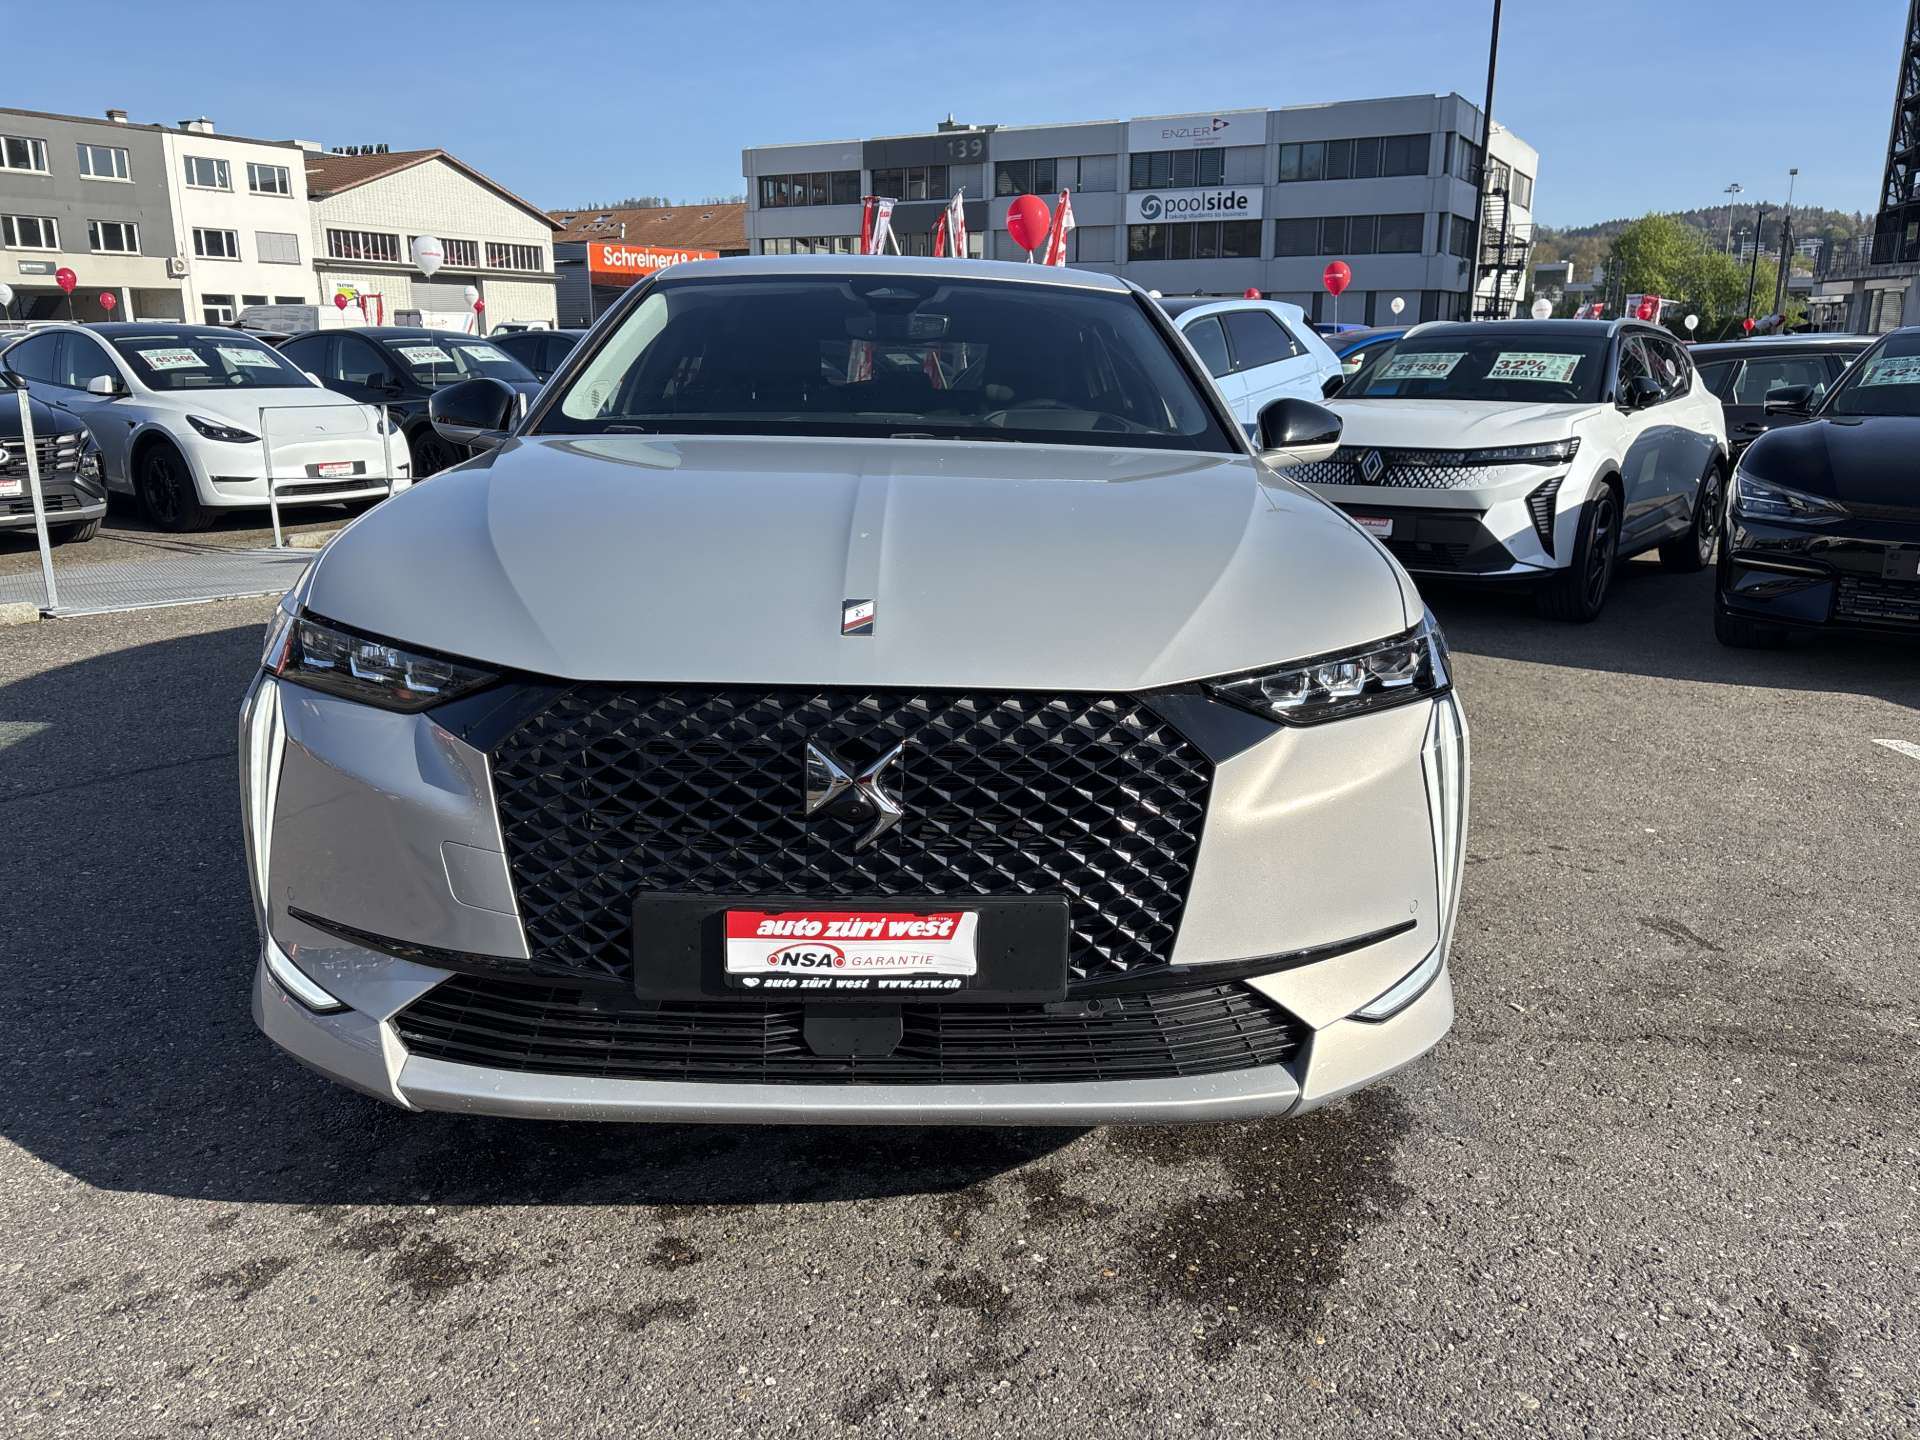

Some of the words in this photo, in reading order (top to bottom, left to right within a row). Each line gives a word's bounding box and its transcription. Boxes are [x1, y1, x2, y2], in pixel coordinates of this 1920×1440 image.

[1162, 127, 1211, 138] ENZLER
[947, 138, 983, 158] 139
[1164, 191, 1248, 219] poolside
[603, 246, 708, 269] Schreiner48h
[1496, 360, 1547, 371] 32%
[1882, 367, 1920, 377] 42'
[756, 918, 823, 937] auto
[822, 918, 886, 938] züri
[888, 917, 954, 937] west
[781, 952, 832, 968] NSA
[851, 955, 934, 966] GARANTIE
[763, 978, 798, 988] auto
[800, 977, 833, 988] züri
[836, 979, 870, 989] west
[878, 979, 962, 989] www.azw.ch
